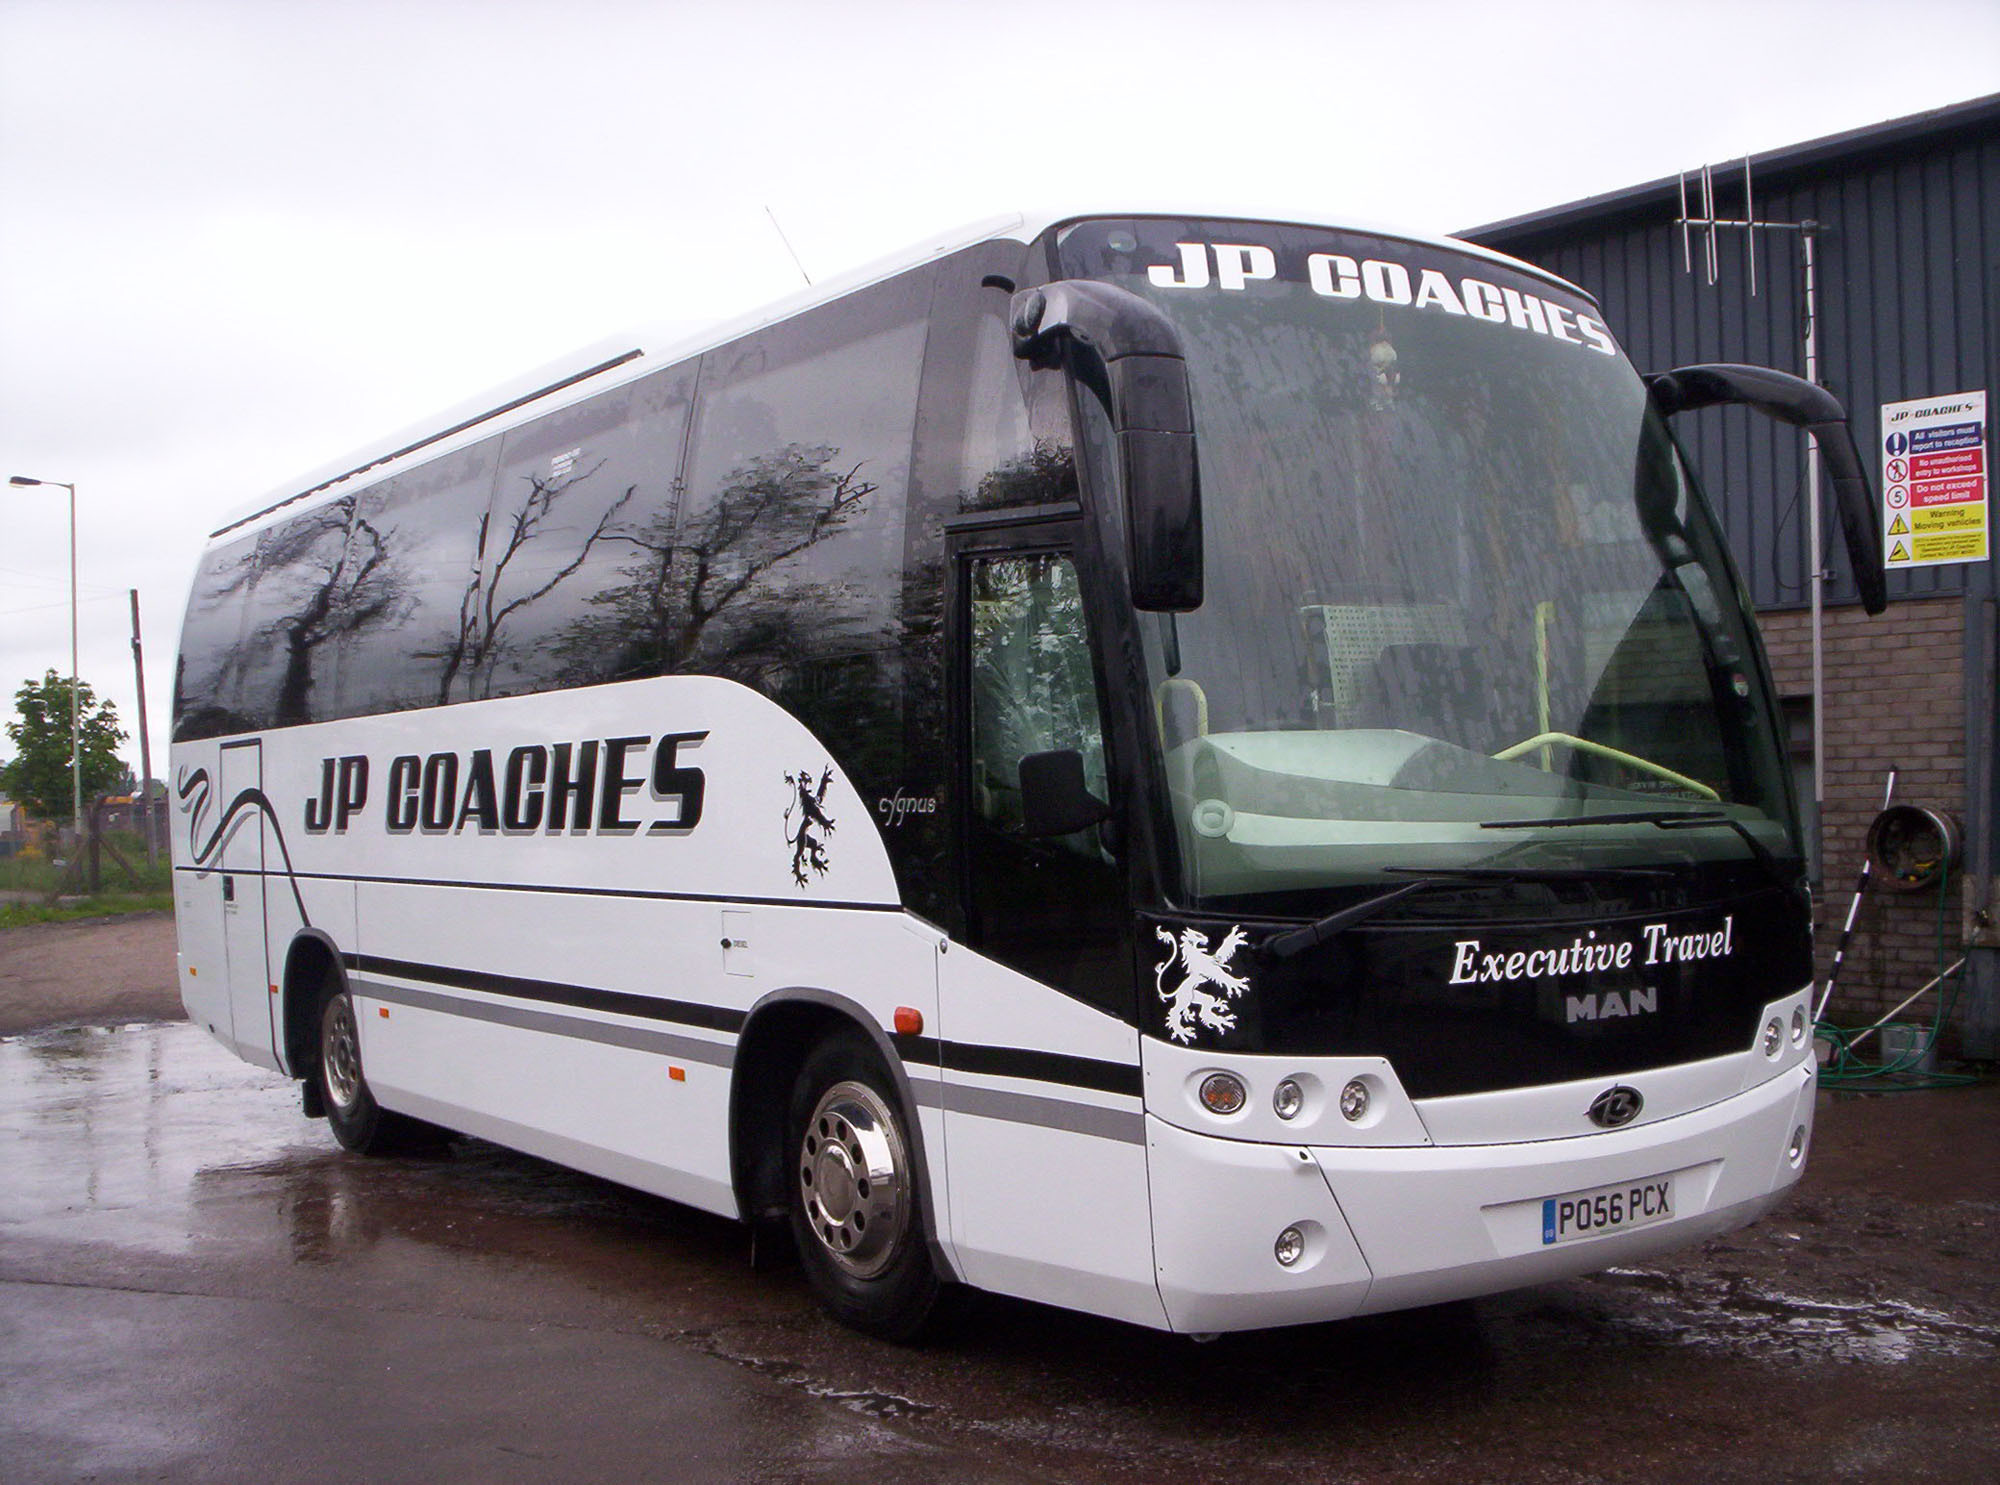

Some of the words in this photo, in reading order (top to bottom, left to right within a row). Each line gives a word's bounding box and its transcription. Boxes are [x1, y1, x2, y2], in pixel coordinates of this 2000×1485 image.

[1147, 242, 1277, 290] JP
[1308, 252, 1616, 356] COACHES
[1890, 410, 1909, 422] JP
[1915, 403, 1973, 418] COACHES
[1916, 484, 1929, 493] Do
[1930, 482, 1945, 492] not
[1946, 479, 1978, 490] exceed
[1923, 492, 1950, 504] speed
[1914, 521, 1945, 530] Moving
[1947, 517, 1982, 527] vehicles
[1929, 508, 1965, 518] Warning
[304, 754, 369, 836] JP
[385, 731, 710, 837] COACHES
[879, 785, 937, 827] cygnus
[1448, 930, 1632, 985] Executive
[1643, 916, 1734, 967] Travel
[1566, 986, 1658, 1024] MAN
[1559, 1192, 1623, 1235] PO56
[1629, 1181, 1669, 1221] PCX
